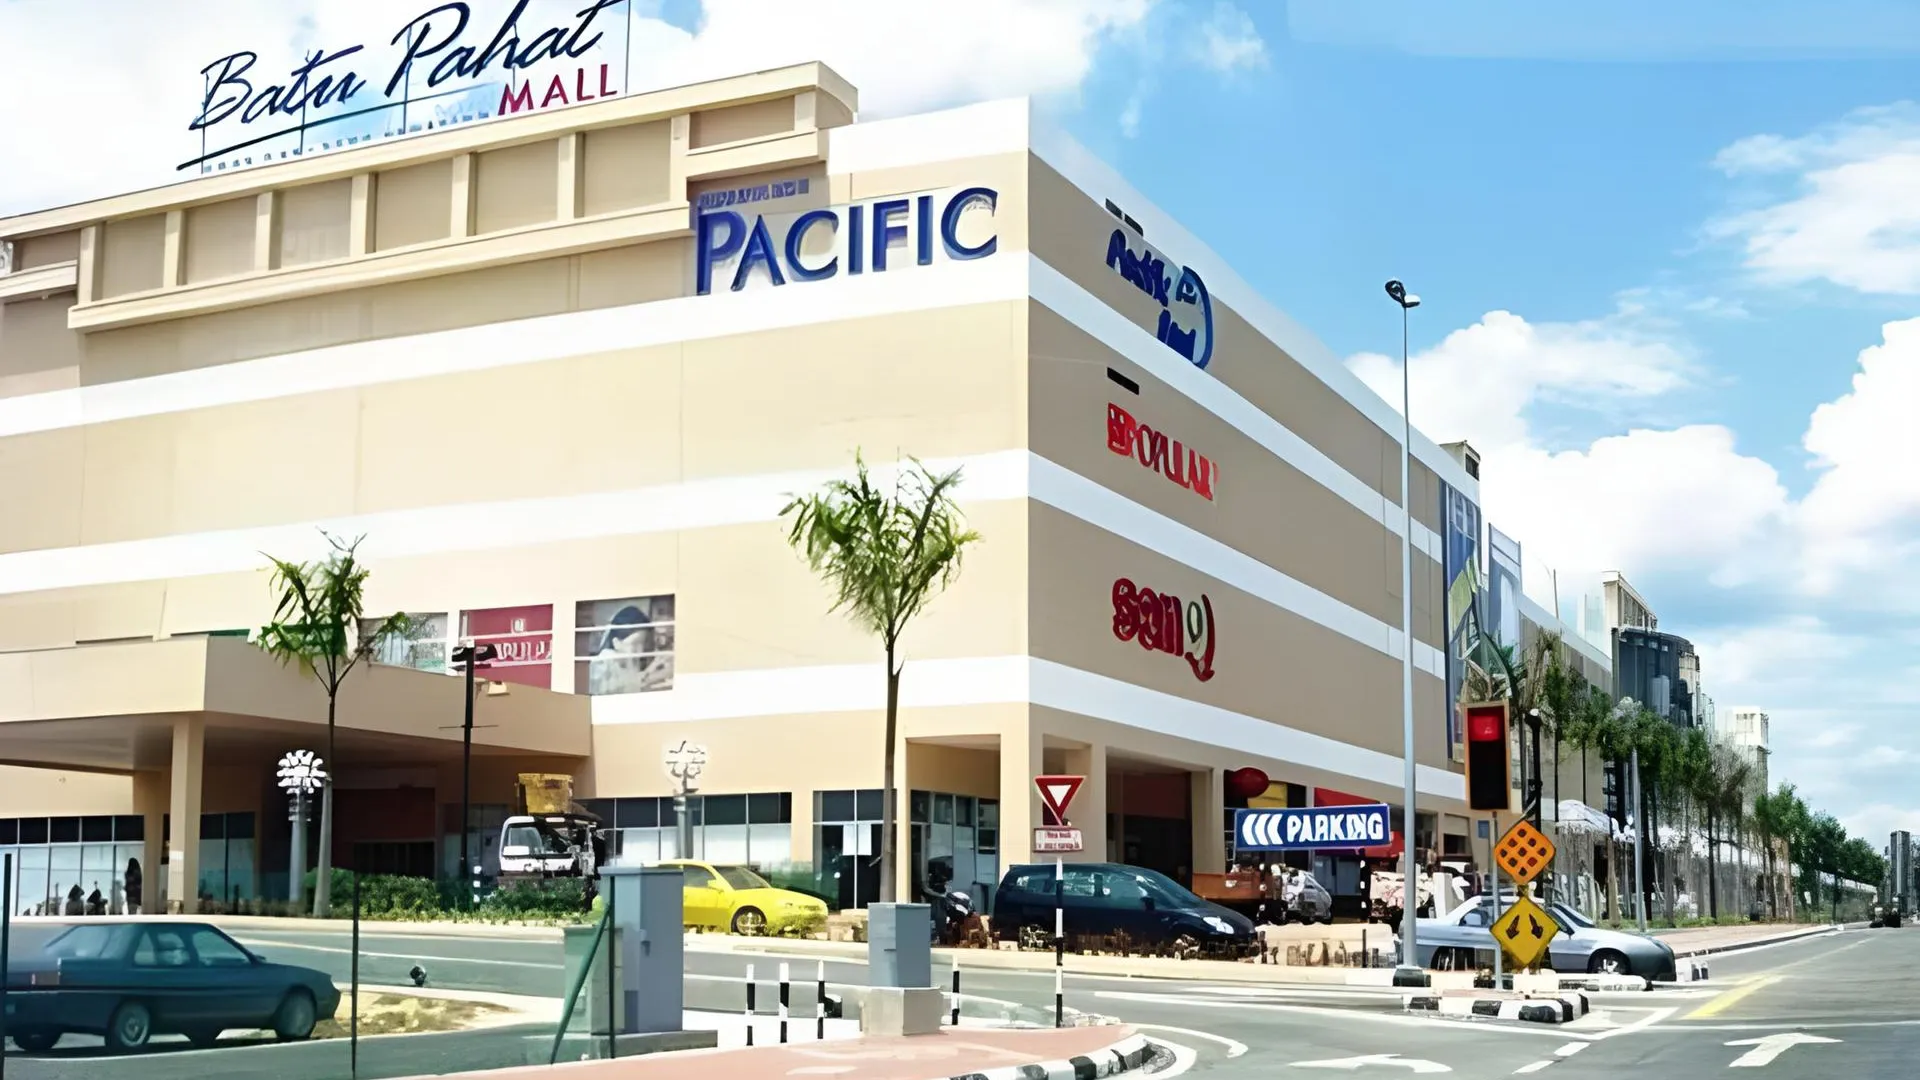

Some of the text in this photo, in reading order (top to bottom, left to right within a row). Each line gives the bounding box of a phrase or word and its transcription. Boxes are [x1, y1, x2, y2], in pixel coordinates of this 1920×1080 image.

[189, 0, 627, 130] Batu Pahat
[498, 64, 618, 116] MALL
[696, 187, 999, 297] PACIFIC
[1286, 812, 1384, 843] PARKING
